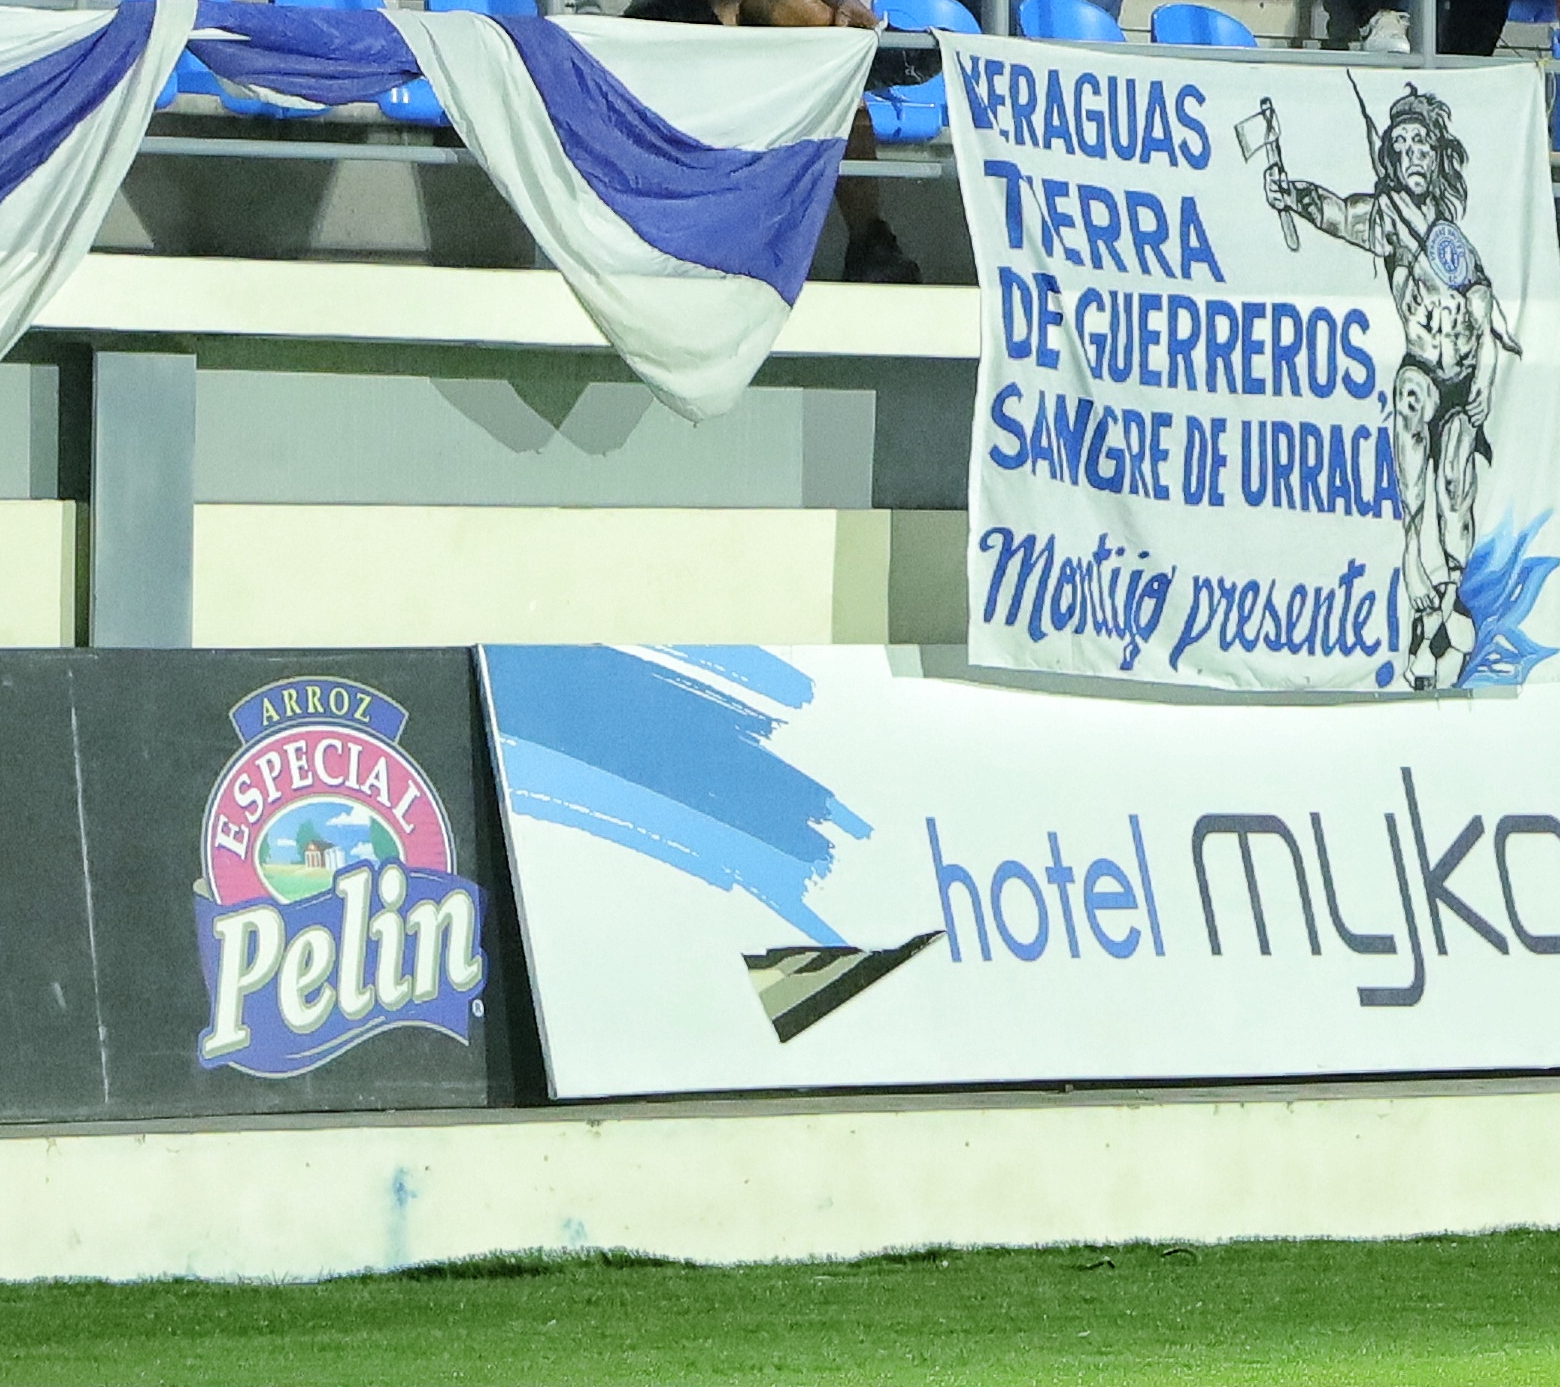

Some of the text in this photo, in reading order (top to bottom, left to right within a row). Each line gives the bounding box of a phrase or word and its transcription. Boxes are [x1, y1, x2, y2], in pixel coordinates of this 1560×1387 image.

[956, 50, 1212, 171] VERAGUAS
[984, 159, 1226, 283] TIERRA
[1000, 264, 1064, 370] DE
[989, 381, 1172, 501] SANGRE
[1183, 416, 1226, 506] DE
[979, 527, 1178, 671] Montijo
[260, 684, 370, 725] ARROZ
[215, 739, 418, 859] ESPECIAL
[928, 815, 1166, 967] hotel
[202, 866, 484, 1065] Pelin
